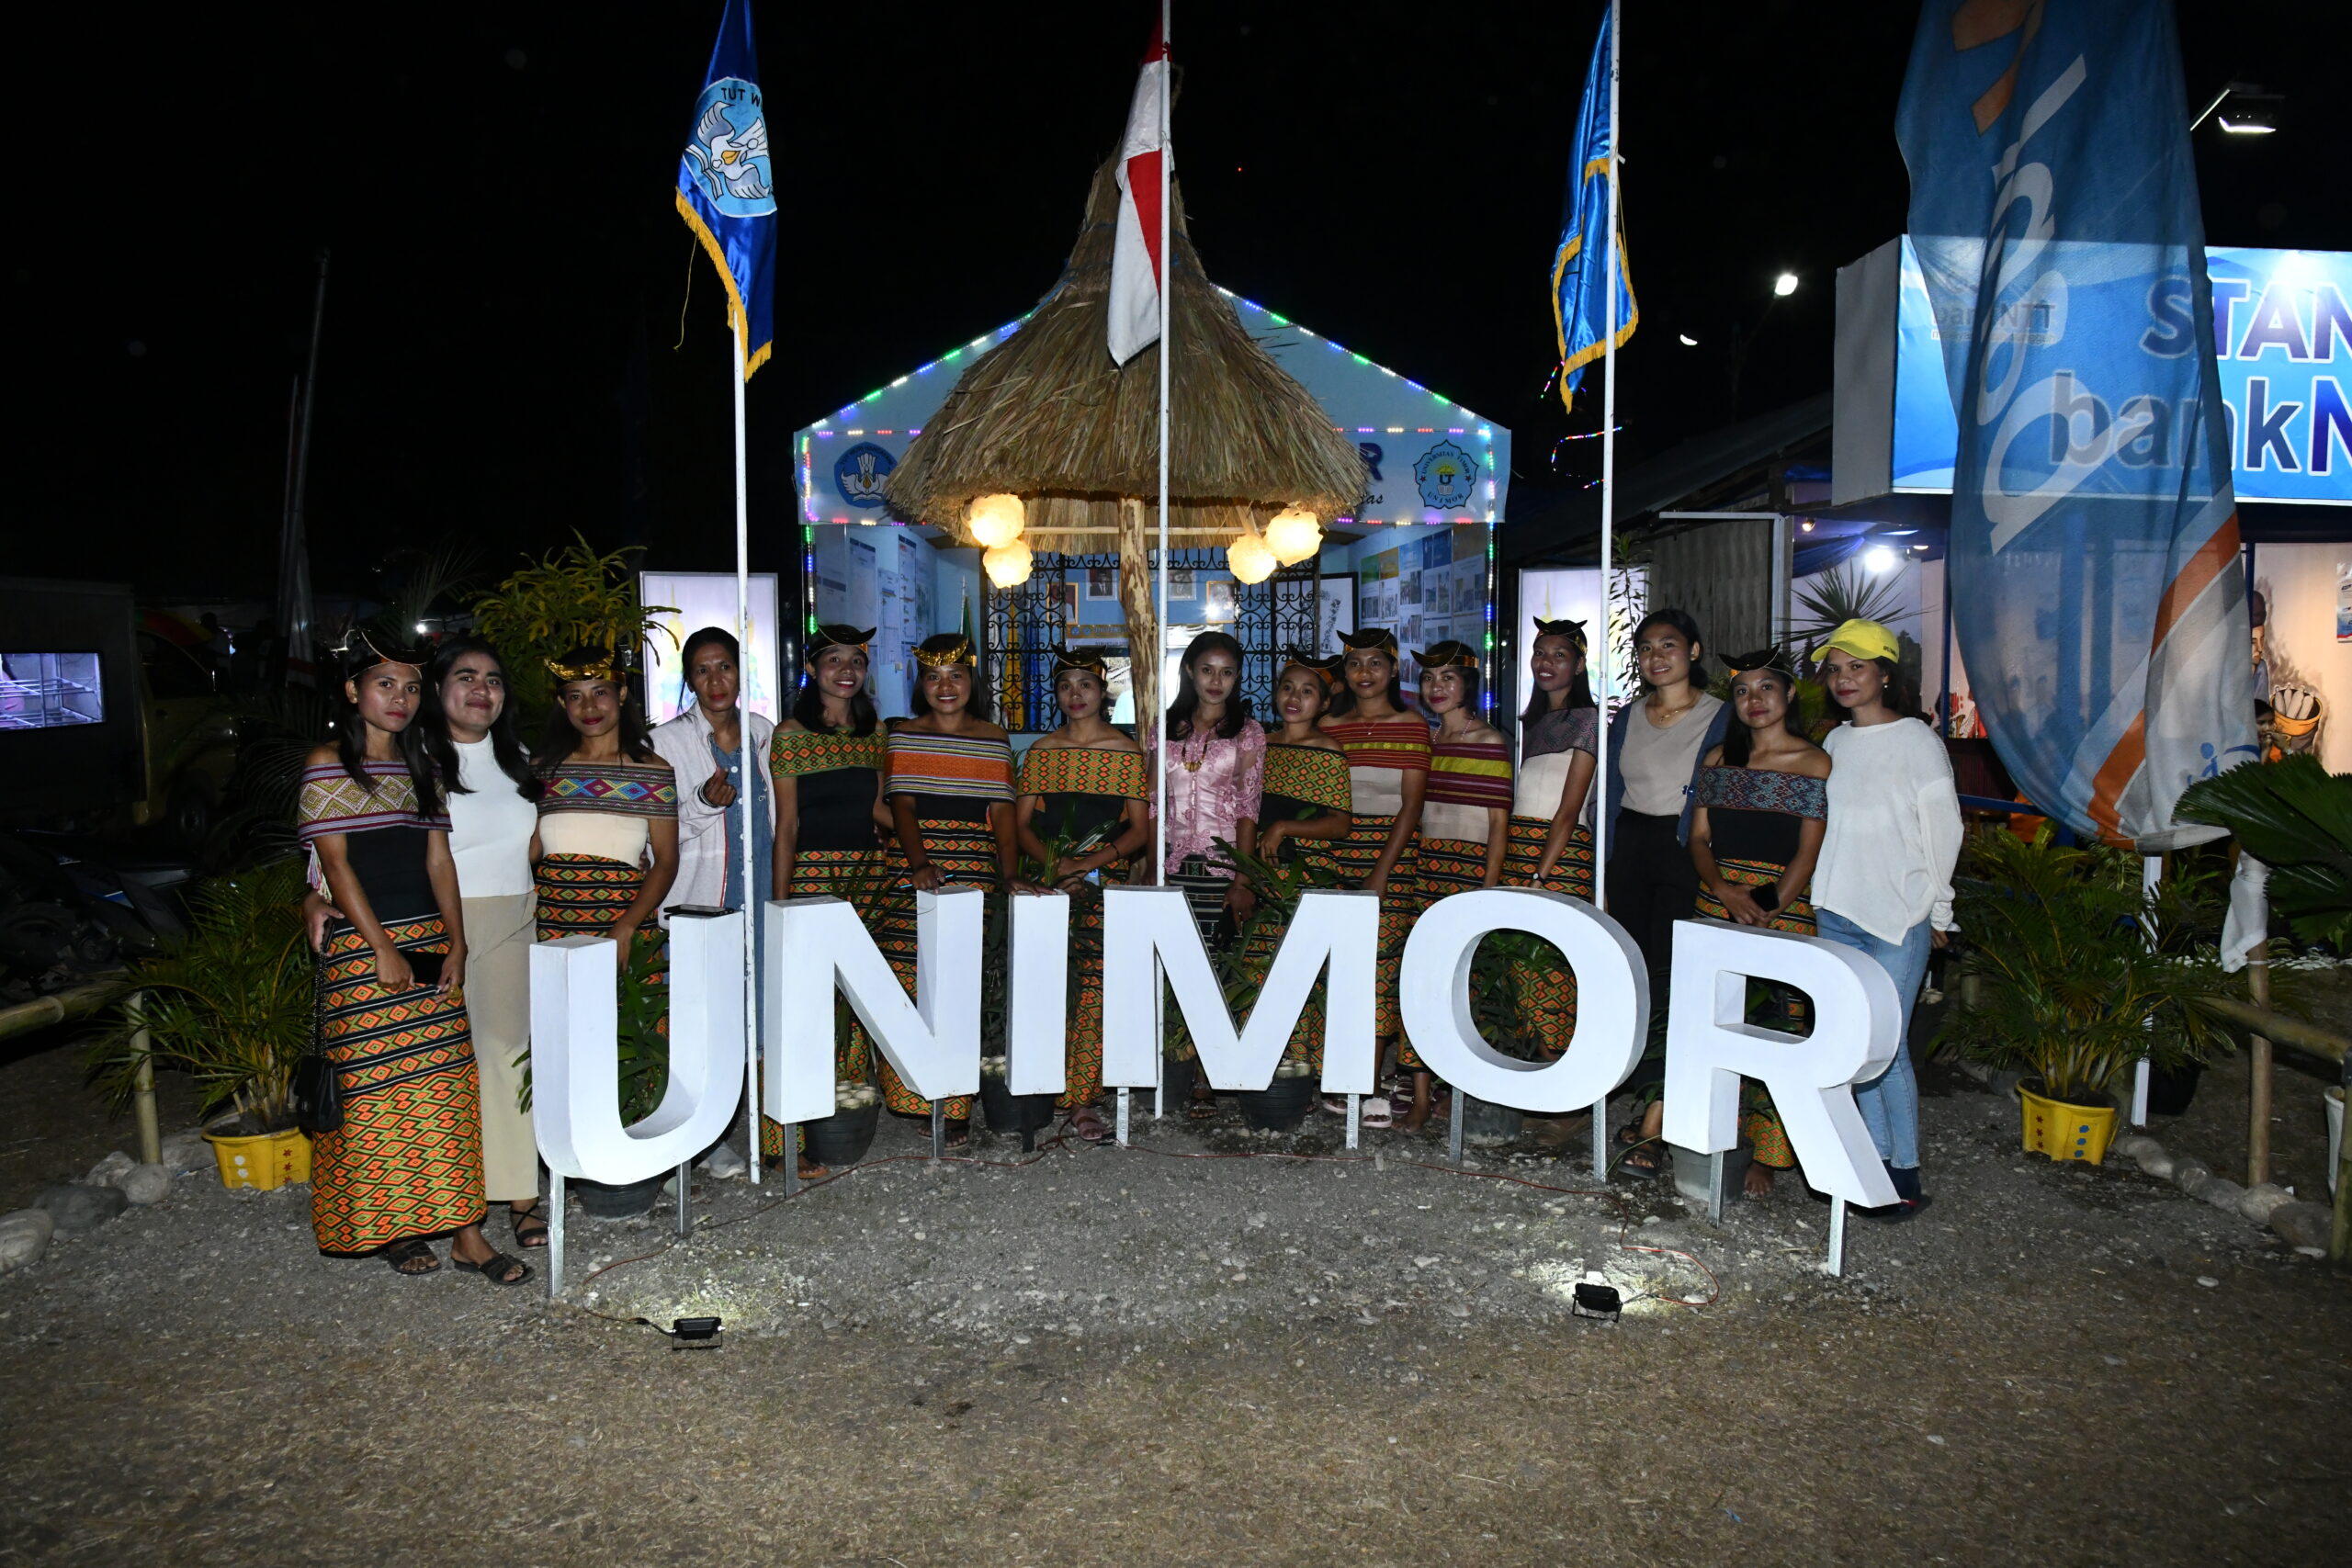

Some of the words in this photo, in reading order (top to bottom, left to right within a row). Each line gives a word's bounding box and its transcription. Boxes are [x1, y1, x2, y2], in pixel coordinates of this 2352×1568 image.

[720, 87, 746, 101] TUT
[751, 92, 763, 109] W
[1421, 450, 1454, 475] UNIVERSITAS
[1456, 455, 1471, 474] TIMOR
[1427, 491, 1464, 504] UNIMOR
[529, 887, 1901, 1209] UNIMOR
